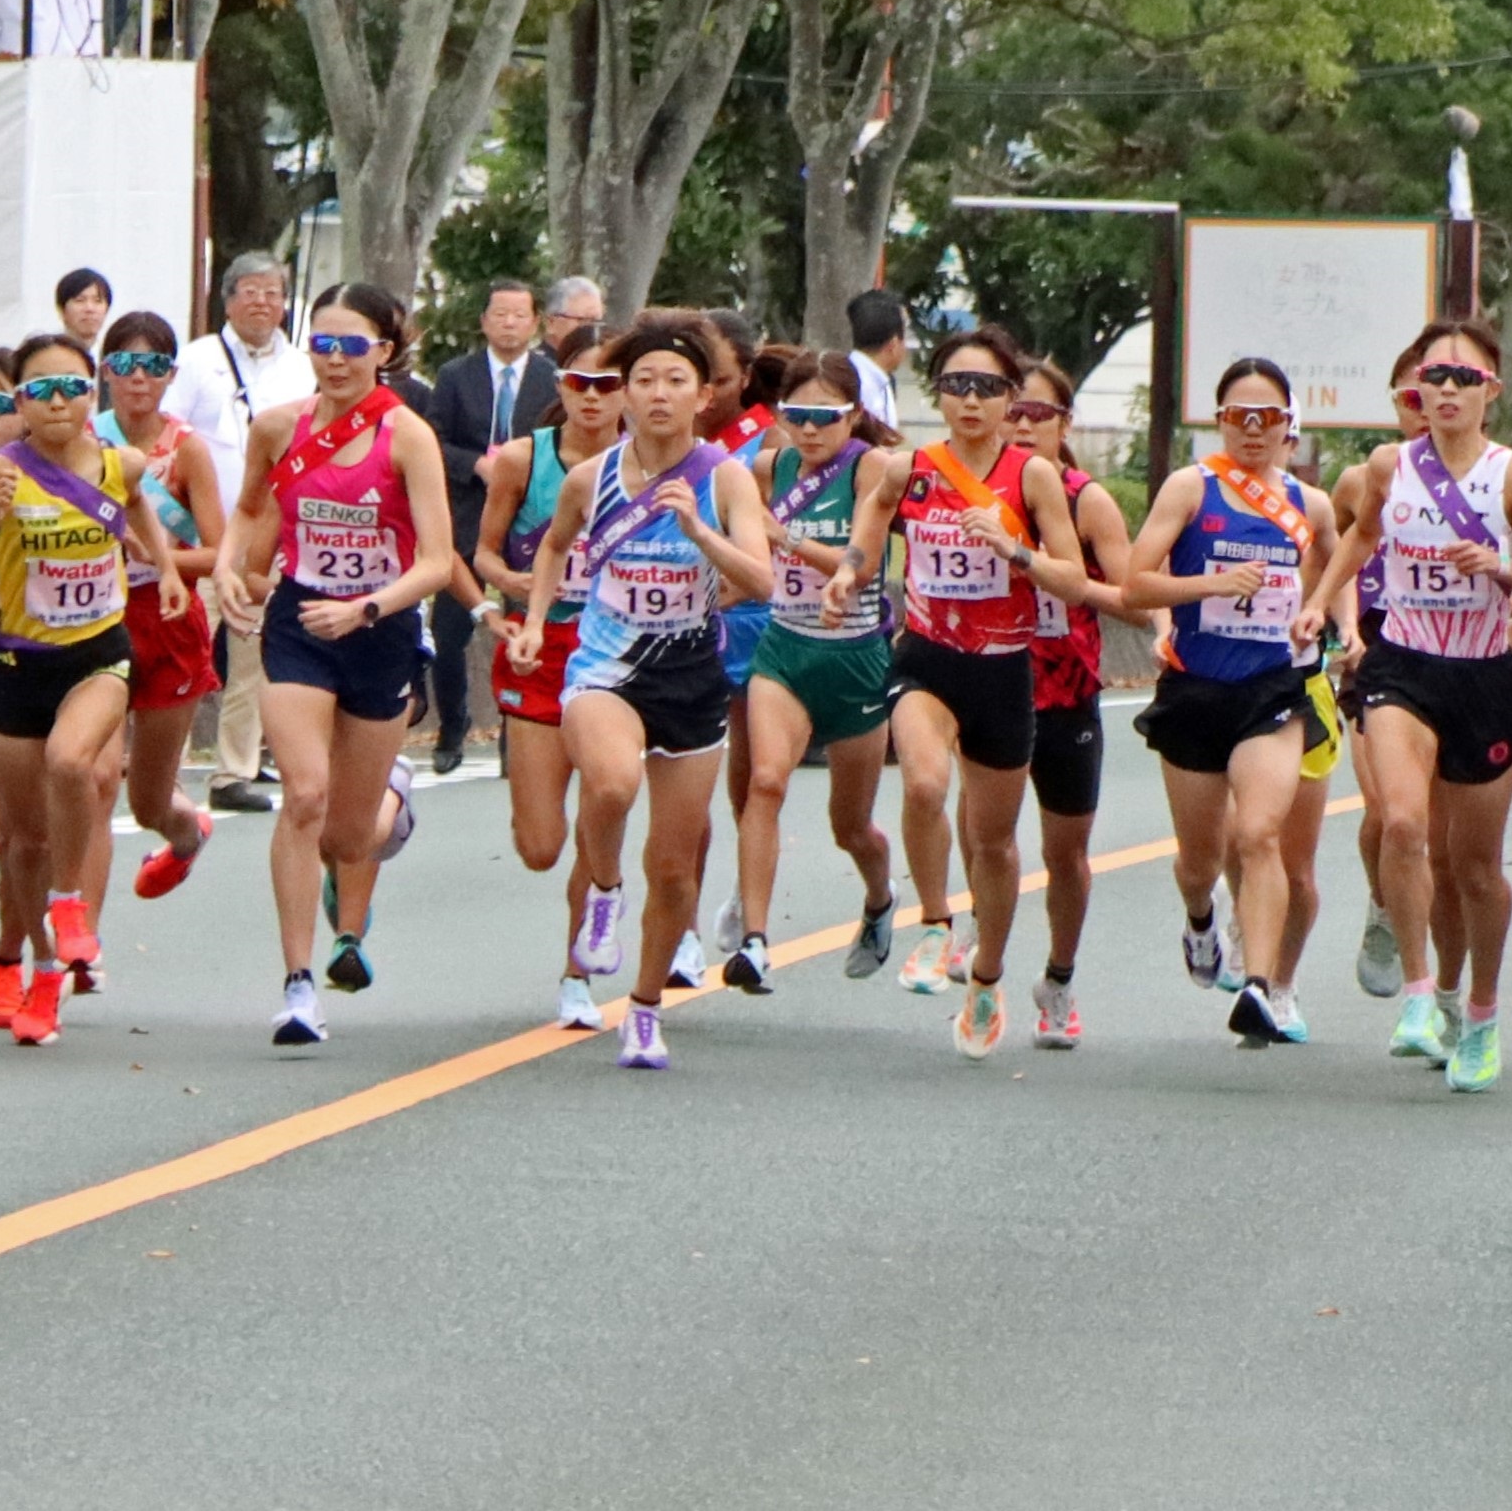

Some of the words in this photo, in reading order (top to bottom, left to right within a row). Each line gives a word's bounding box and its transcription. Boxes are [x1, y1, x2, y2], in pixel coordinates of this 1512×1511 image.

[301, 501, 375, 525] SENKO
[318, 550, 390, 580] 23-1
[609, 561, 700, 584] Iwatani
[929, 549, 997, 580] 13-1
[1407, 563, 1475, 593] 15-1
[625, 586, 694, 615] 19-1
